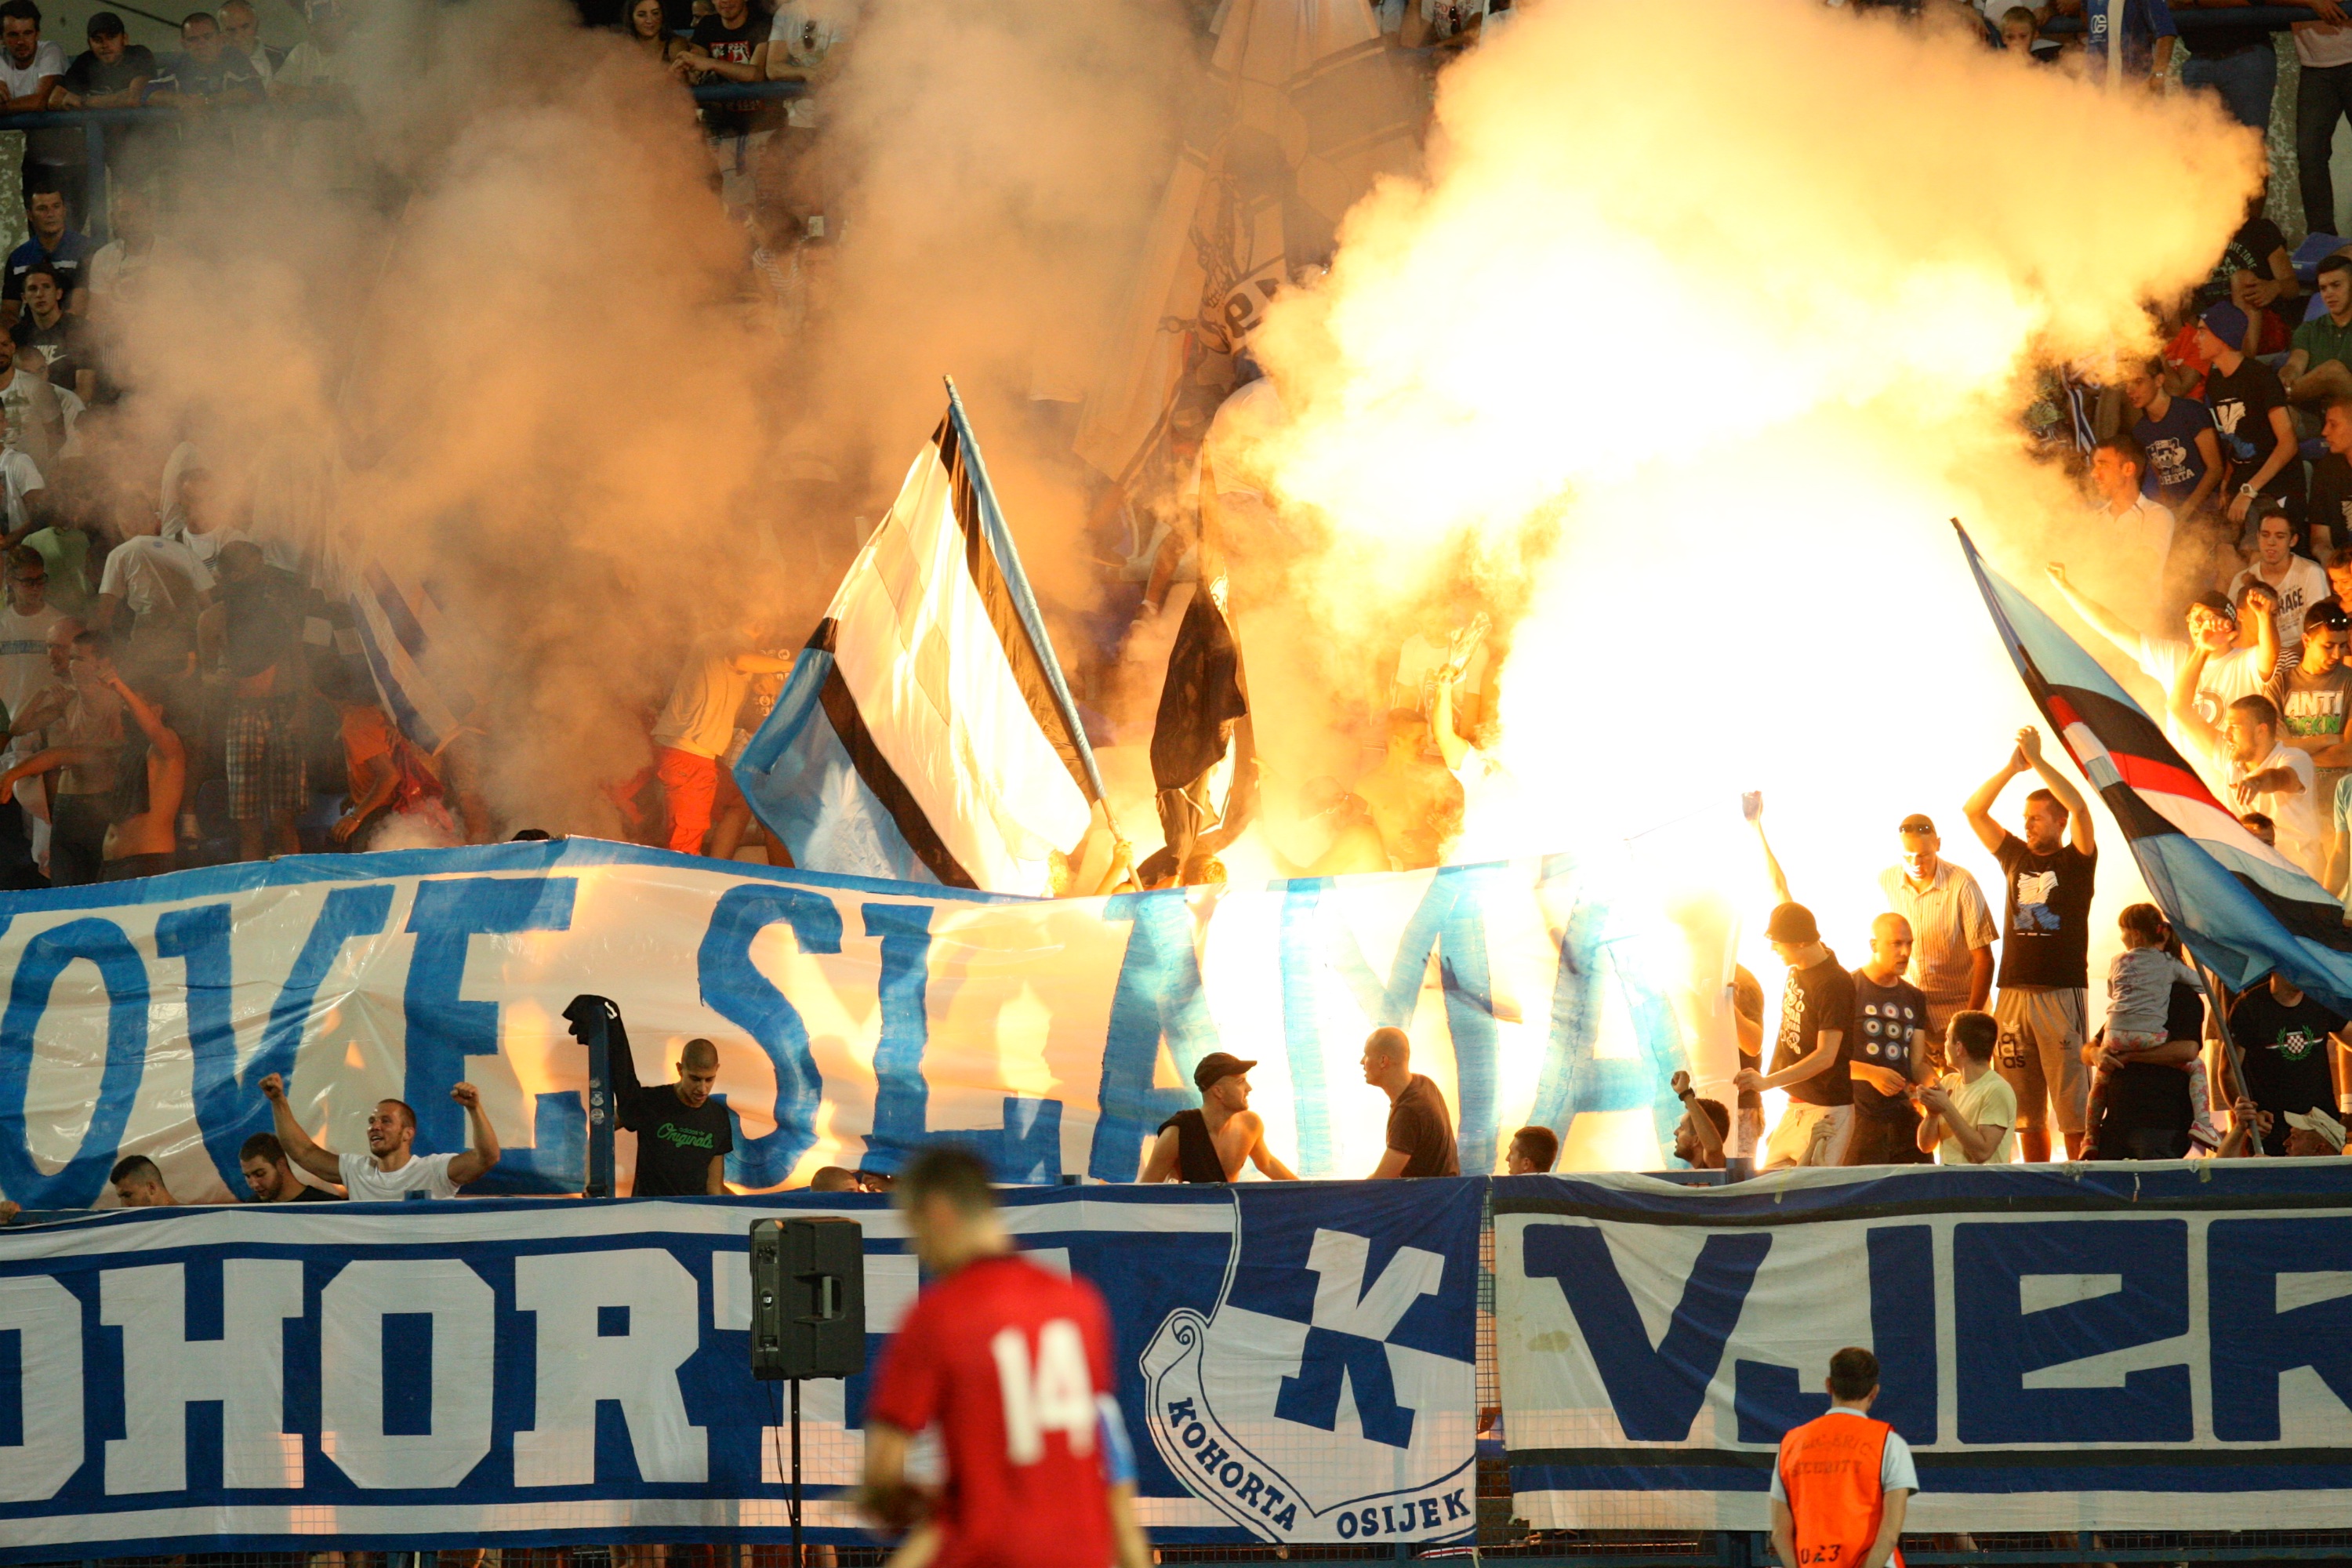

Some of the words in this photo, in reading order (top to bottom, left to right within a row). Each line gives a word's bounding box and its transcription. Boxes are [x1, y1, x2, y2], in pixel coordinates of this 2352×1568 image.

[2240, 249, 2258, 270] ZONE
[2284, 690, 2343, 717] ANTI
[0, 877, 588, 1208] OVE
[657, 1123, 714, 1149] Originals
[1274, 1228, 1445, 1450] K
[990, 1318, 1096, 1468] 14
[1168, 1397, 1298, 1532] KOHORTA
[1336, 1487, 1472, 1539] OSIJEK
